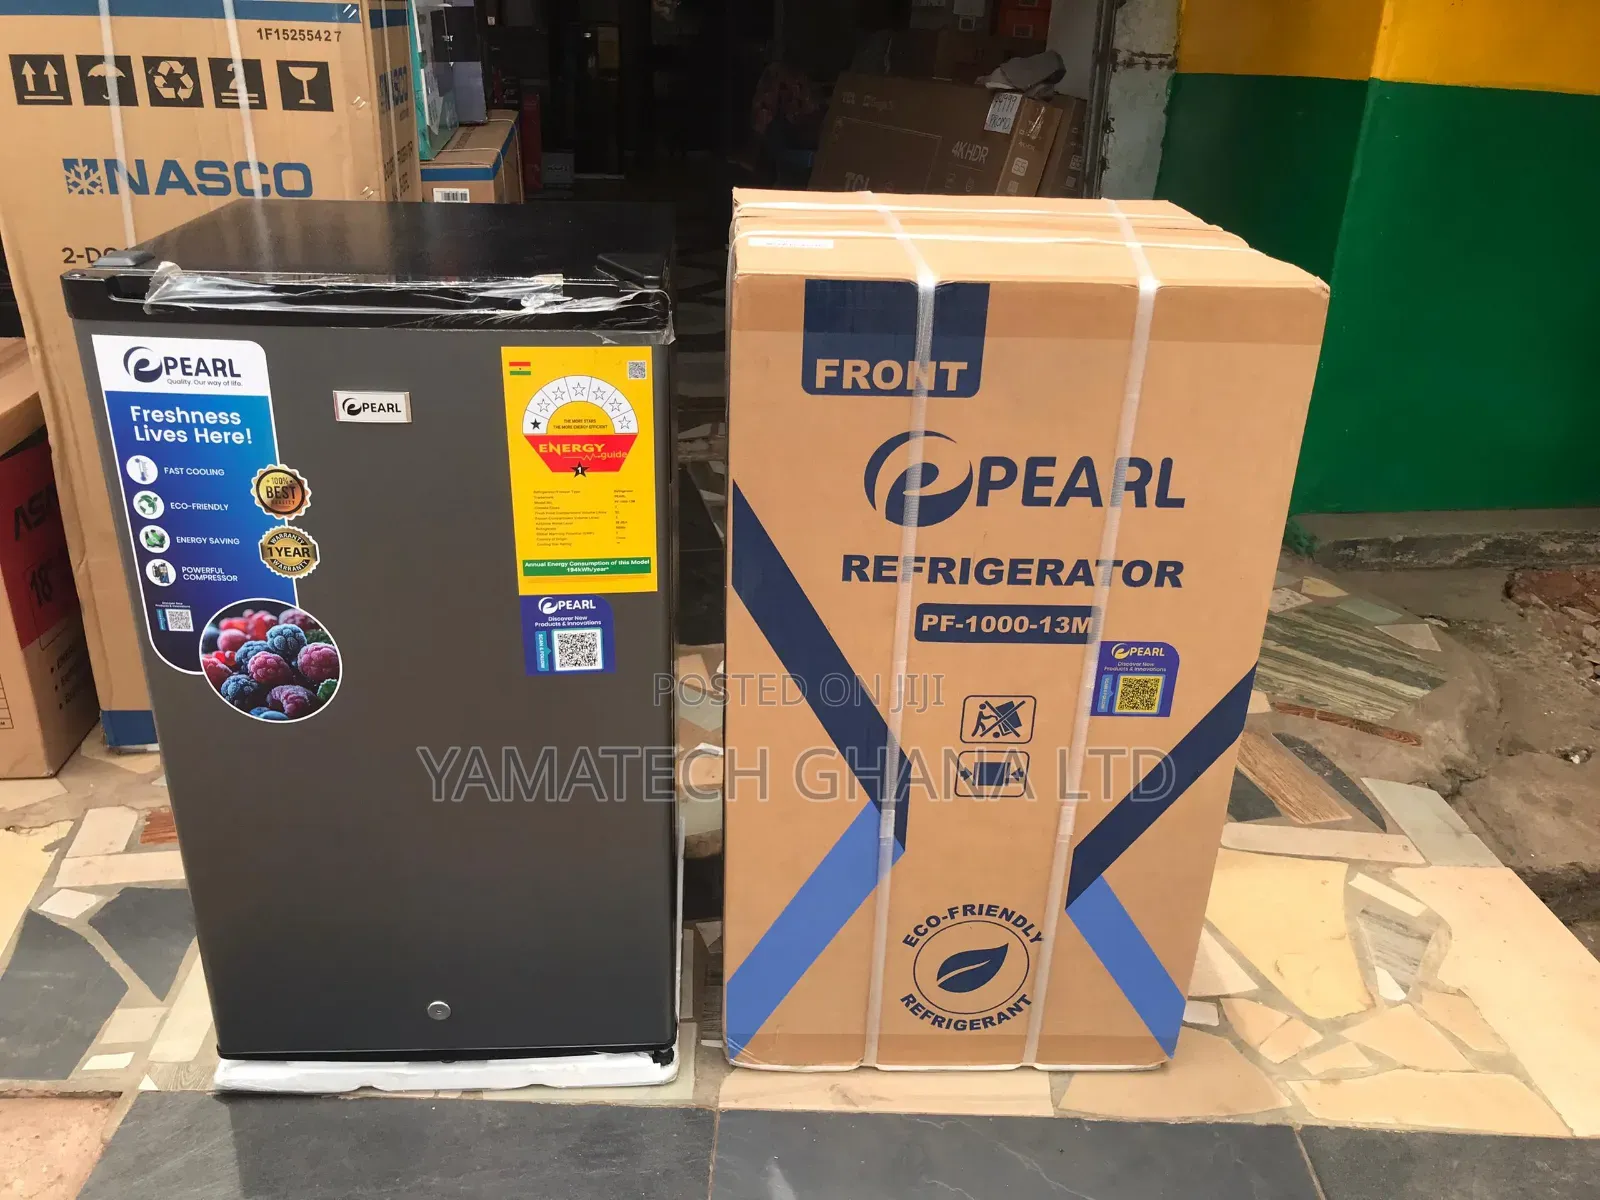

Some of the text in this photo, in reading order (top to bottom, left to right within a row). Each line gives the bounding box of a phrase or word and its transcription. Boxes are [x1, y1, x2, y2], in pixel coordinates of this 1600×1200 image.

[256, 28, 342, 42] 1F15255427
[103, 158, 314, 198] NASCO
[163, 356, 242, 378] PEARL
[815, 358, 968, 392] FRONT
[167, 378, 192, 387] Quality.
[207, 380, 222, 388] way
[362, 402, 402, 413] PEARL
[130, 405, 242, 426] Freshness
[133, 425, 253, 445] Lives Here!
[538, 441, 606, 456] ENERGY
[600, 451, 628, 460] guide
[164, 467, 225, 476] FAST COOLING
[577, 466, 582, 474] 1
[271, 477, 289, 485] 100%
[975, 455, 1186, 509] PEARL
[266, 485, 296, 499] BEST
[170, 502, 229, 511] ECO-FRIENDLY
[176, 536, 240, 545] ENERGY SAVING
[270, 533, 305, 545] WARRANTY
[267, 546, 311, 558] 1 YEAR
[182, 566, 225, 575] POWERFUL
[272, 559, 308, 572] WARRANTY
[841, 554, 1185, 588] REFRIGERATOR
[183, 574, 238, 582] COMPRESSOR
[557, 599, 597, 610] PEARL
[921, 614, 1094, 634] PF-1000-13M
[1129, 647, 1165, 657] PEARL
[902, 903, 1045, 948] ECO-FRIENDLY
[900, 993, 1032, 1031] REFRIGERANT
